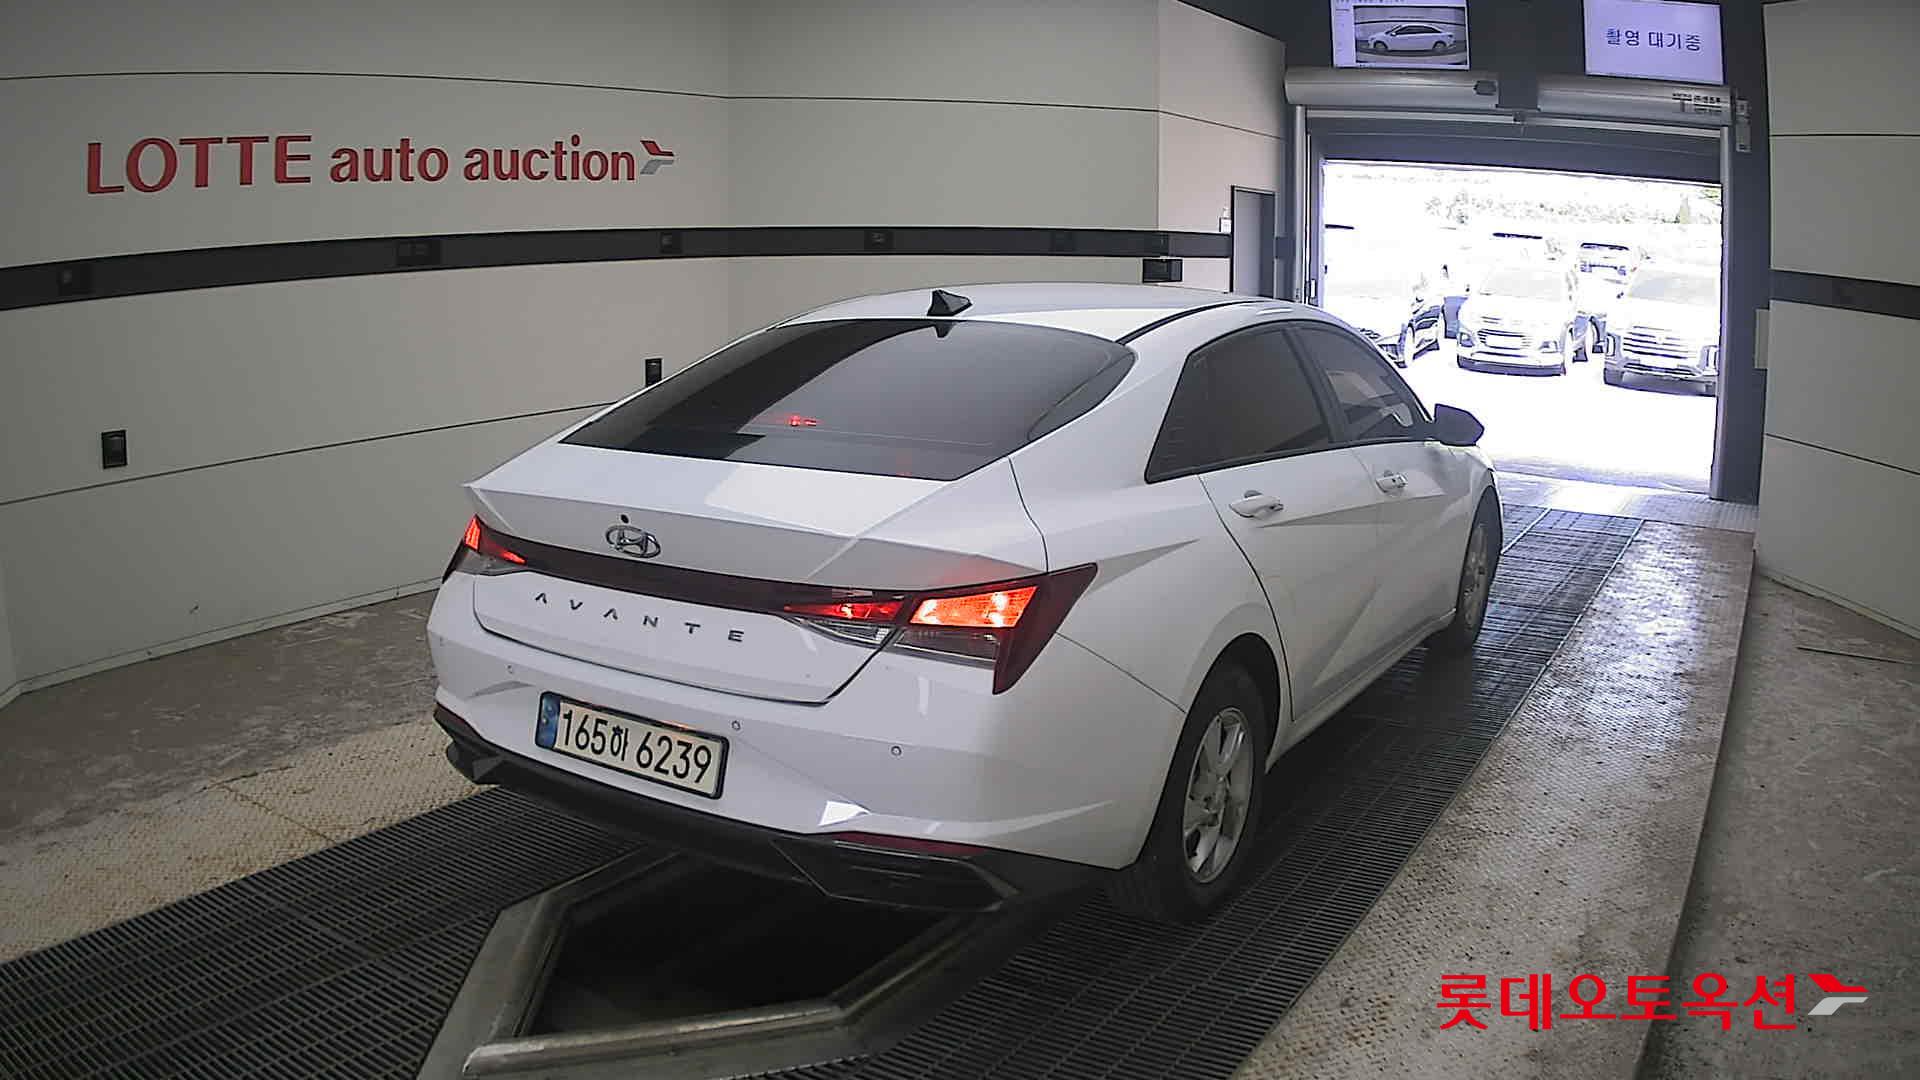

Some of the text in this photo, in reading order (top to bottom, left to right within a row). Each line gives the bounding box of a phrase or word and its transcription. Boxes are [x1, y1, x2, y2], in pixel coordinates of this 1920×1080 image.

[1606, 28, 1702, 52] 촬영 대기중
[86, 134, 636, 194] LOTTE auto auction
[535, 592, 745, 642] AVANTE
[563, 709, 712, 783] 165하 6239
